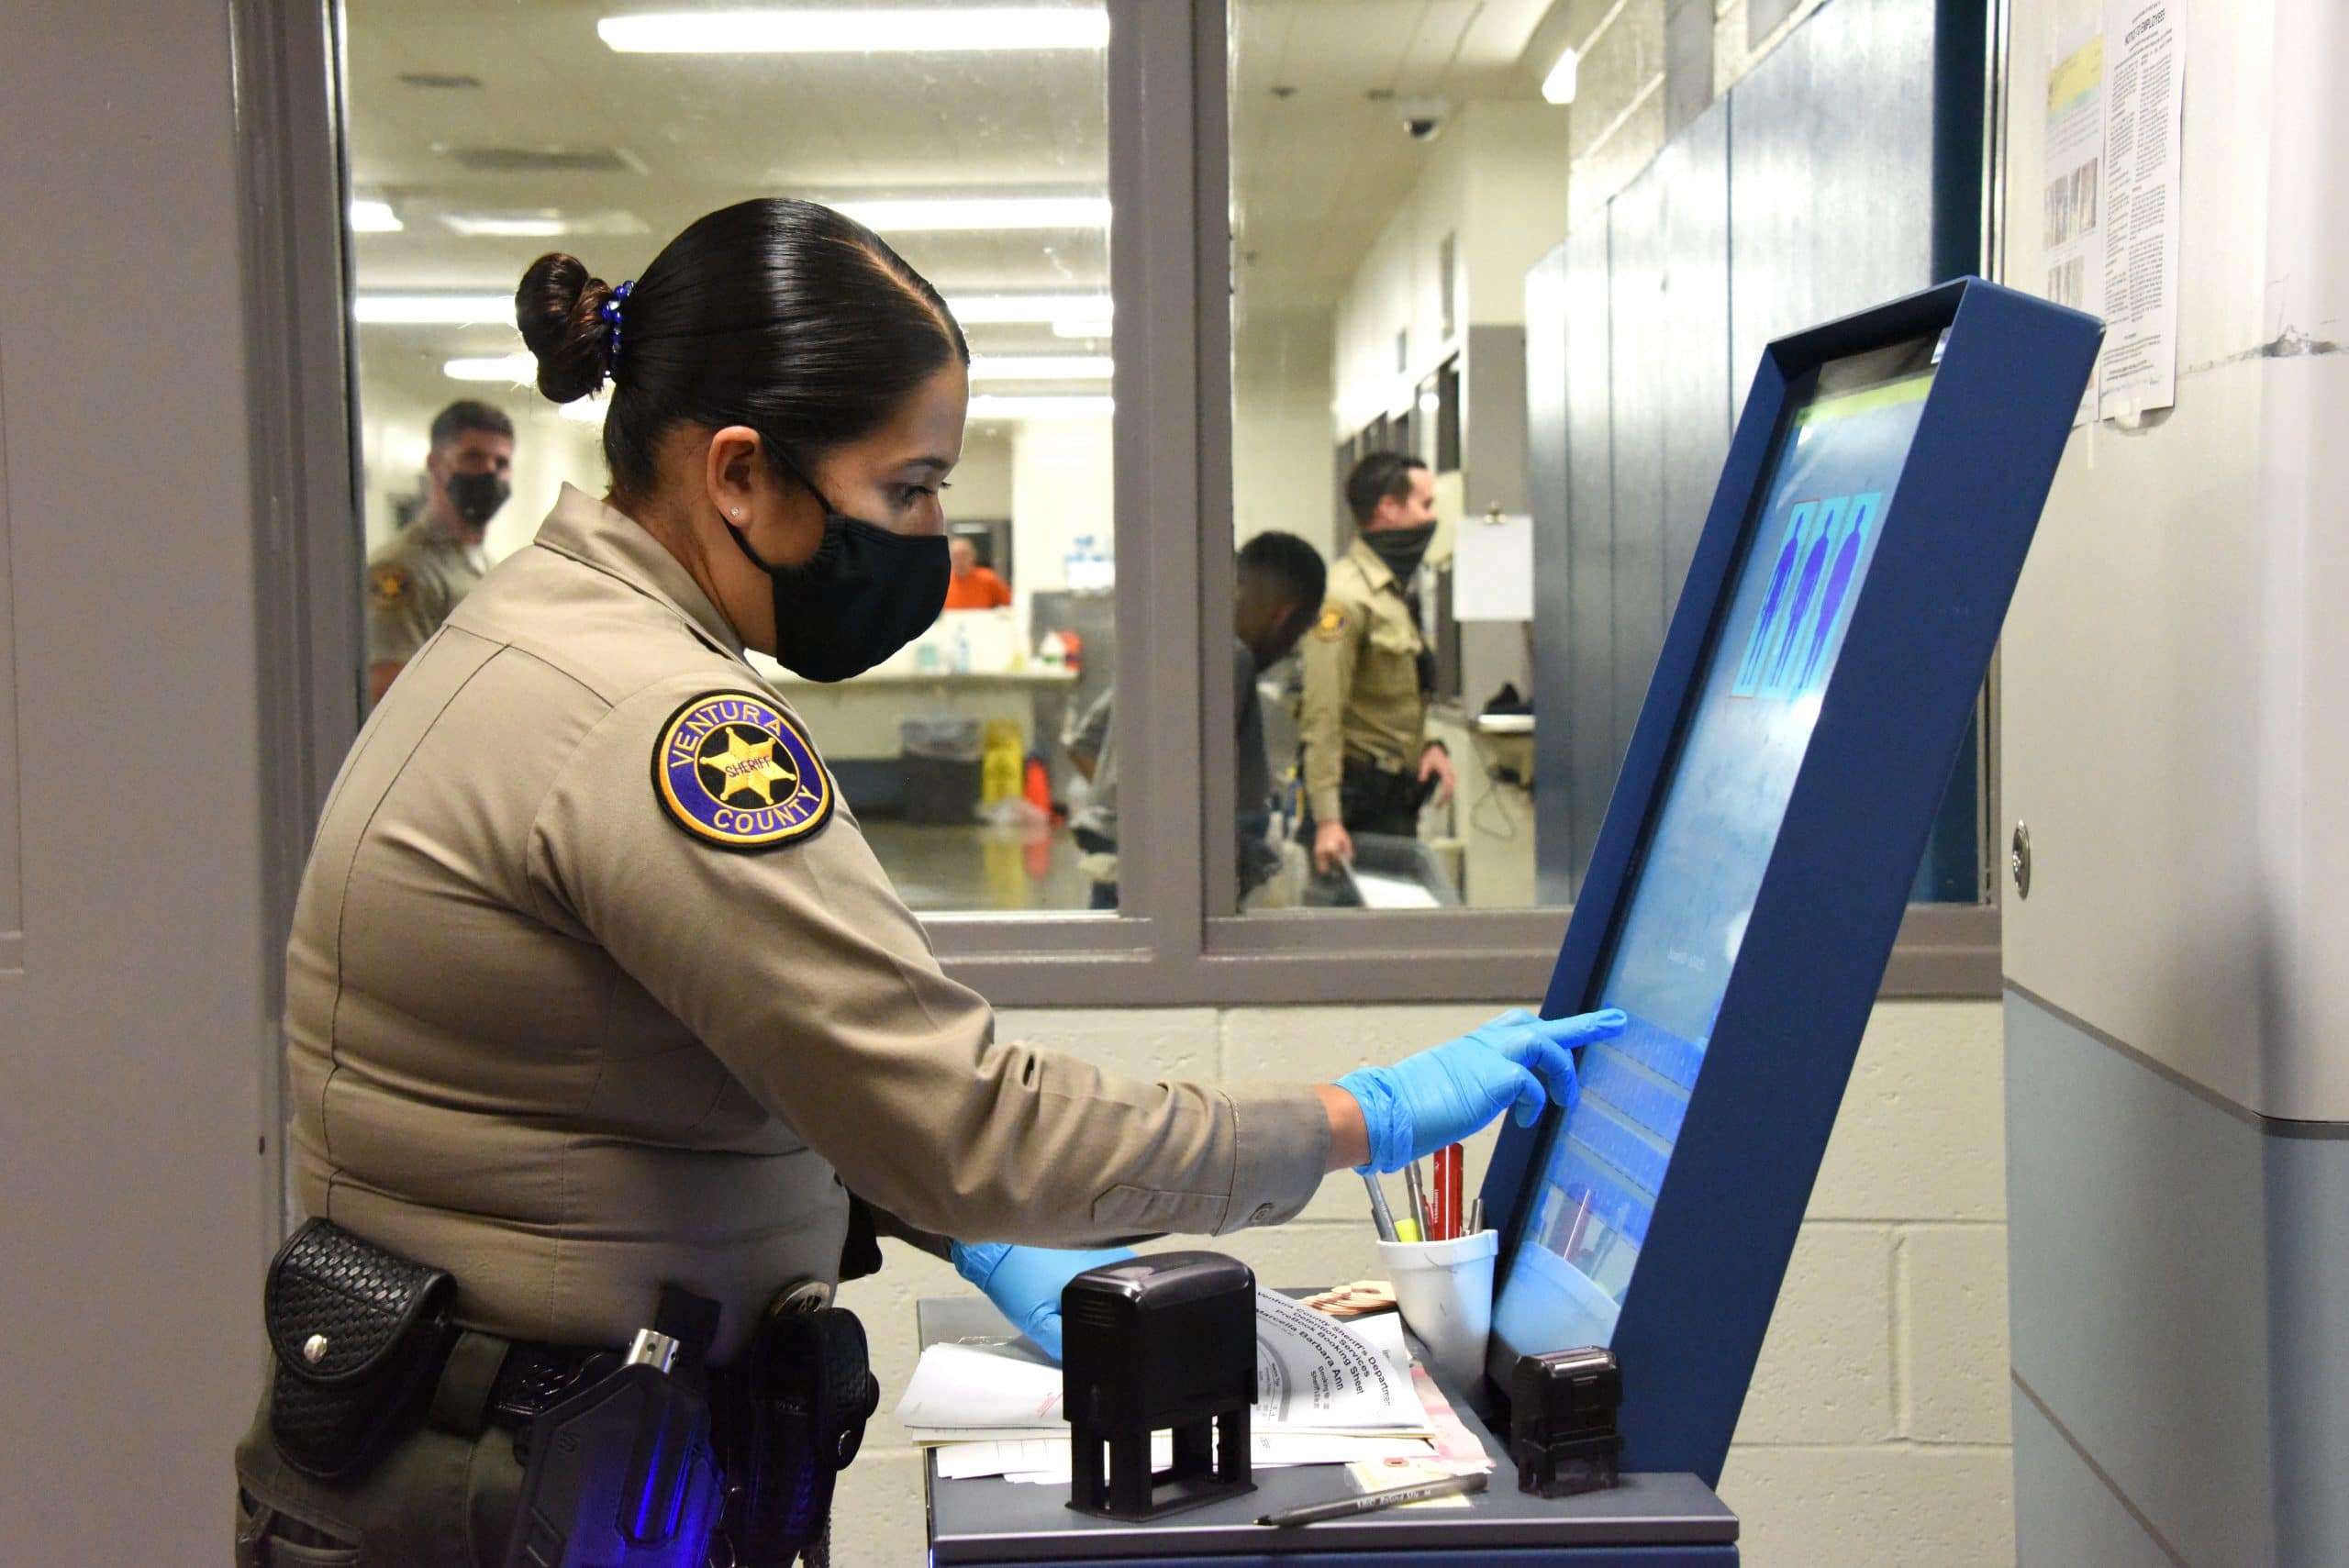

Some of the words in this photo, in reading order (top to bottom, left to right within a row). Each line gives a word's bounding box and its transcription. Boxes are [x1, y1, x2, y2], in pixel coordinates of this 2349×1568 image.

[670, 702, 783, 768] VENTURA
[725, 755, 771, 779] SHERIFF
[713, 784, 820, 833] COUNTY
[1257, 1291, 1294, 1309] Ventura
[1297, 1308, 1330, 1327] County
[1331, 1326, 1368, 1356] Sheriff's
[1293, 1312, 1338, 1340] Detention
[1339, 1339, 1370, 1378] Services
[1299, 1330, 1335, 1367] Barbara
[1332, 1368, 1344, 1391] Ann
[1317, 1331, 1352, 1366] Booking
[1350, 1366, 1364, 1395] Sheet
